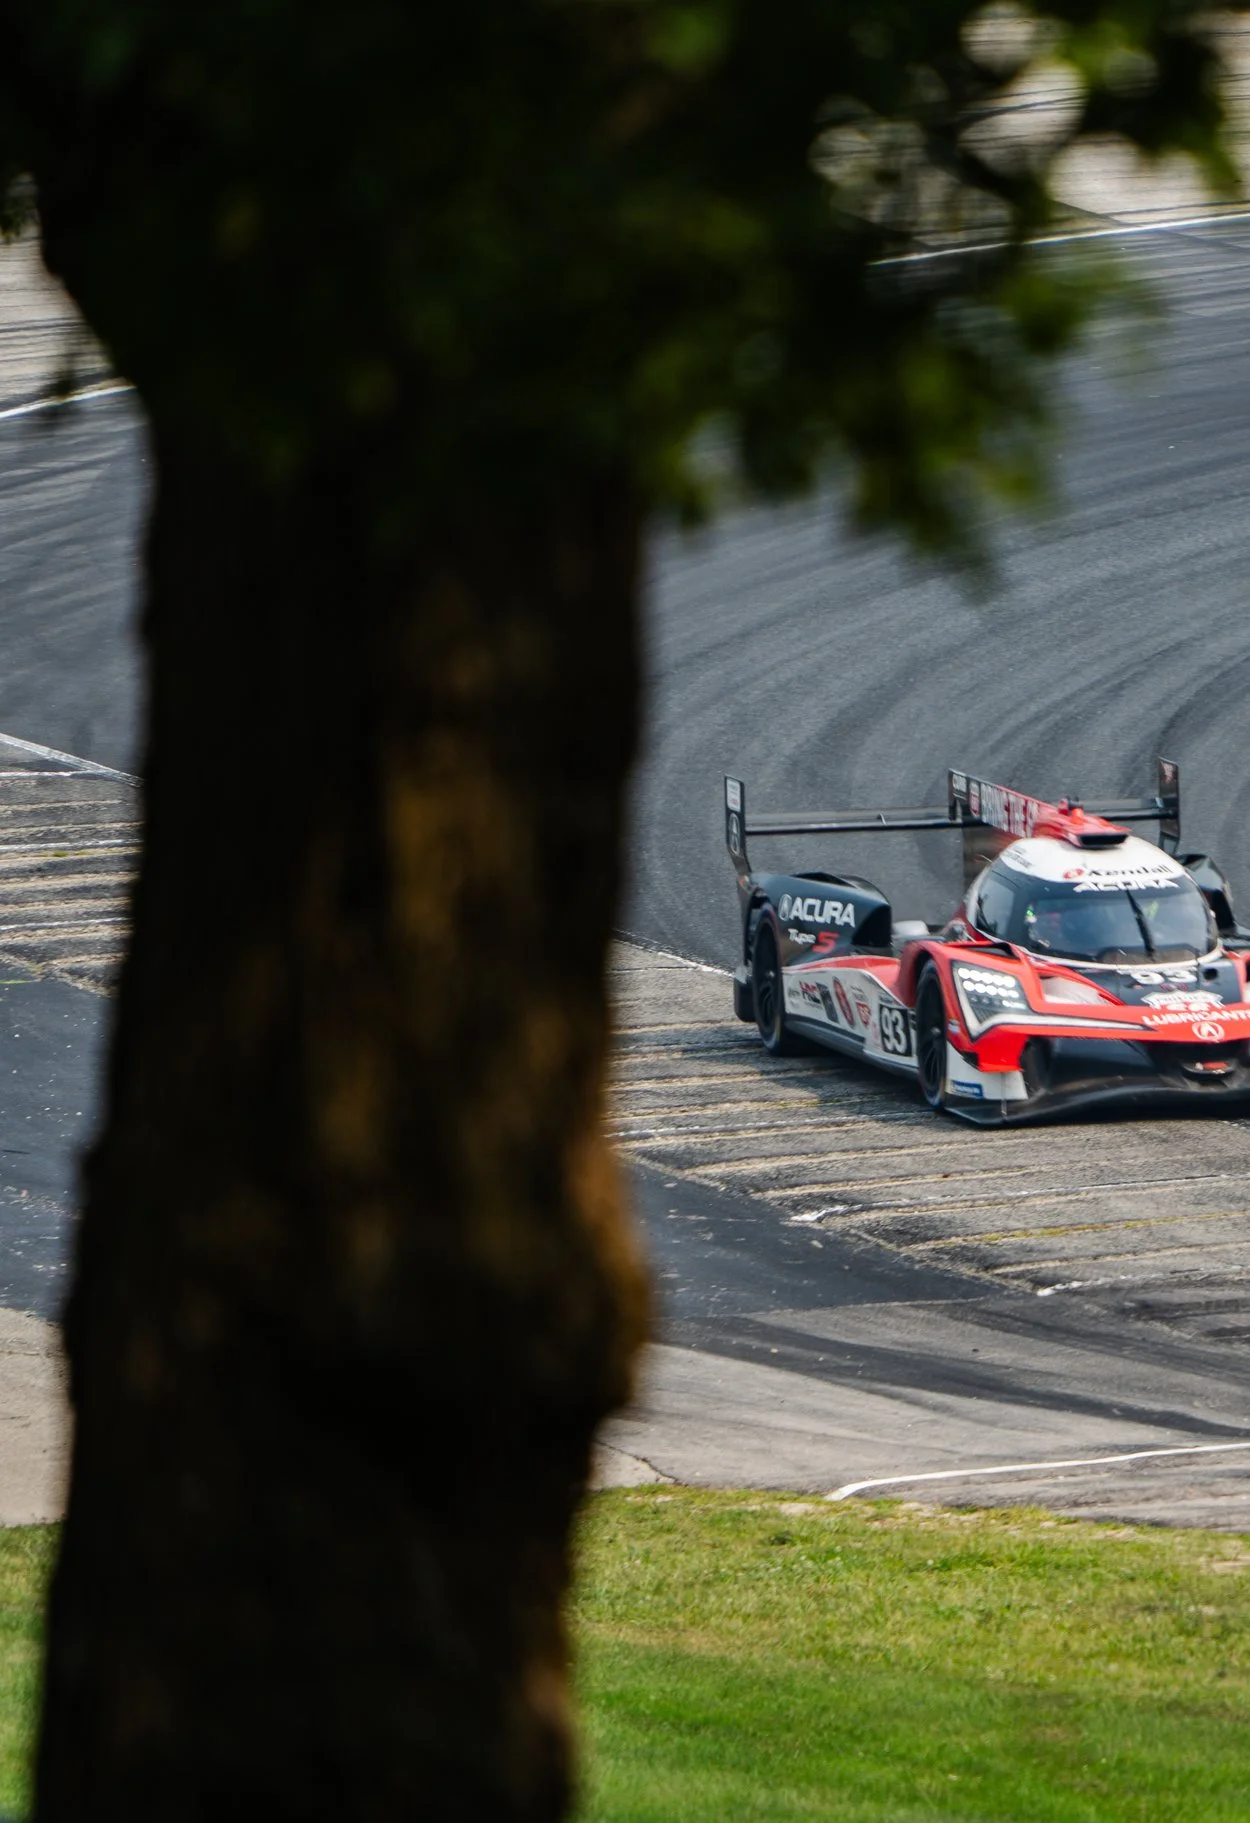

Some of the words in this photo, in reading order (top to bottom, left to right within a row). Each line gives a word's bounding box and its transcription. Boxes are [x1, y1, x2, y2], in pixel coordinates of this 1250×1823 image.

[1088, 864, 1174, 877] Kendall
[789, 896, 855, 928] ACURA
[811, 930, 840, 953] S
[880, 1005, 908, 1055] 93
